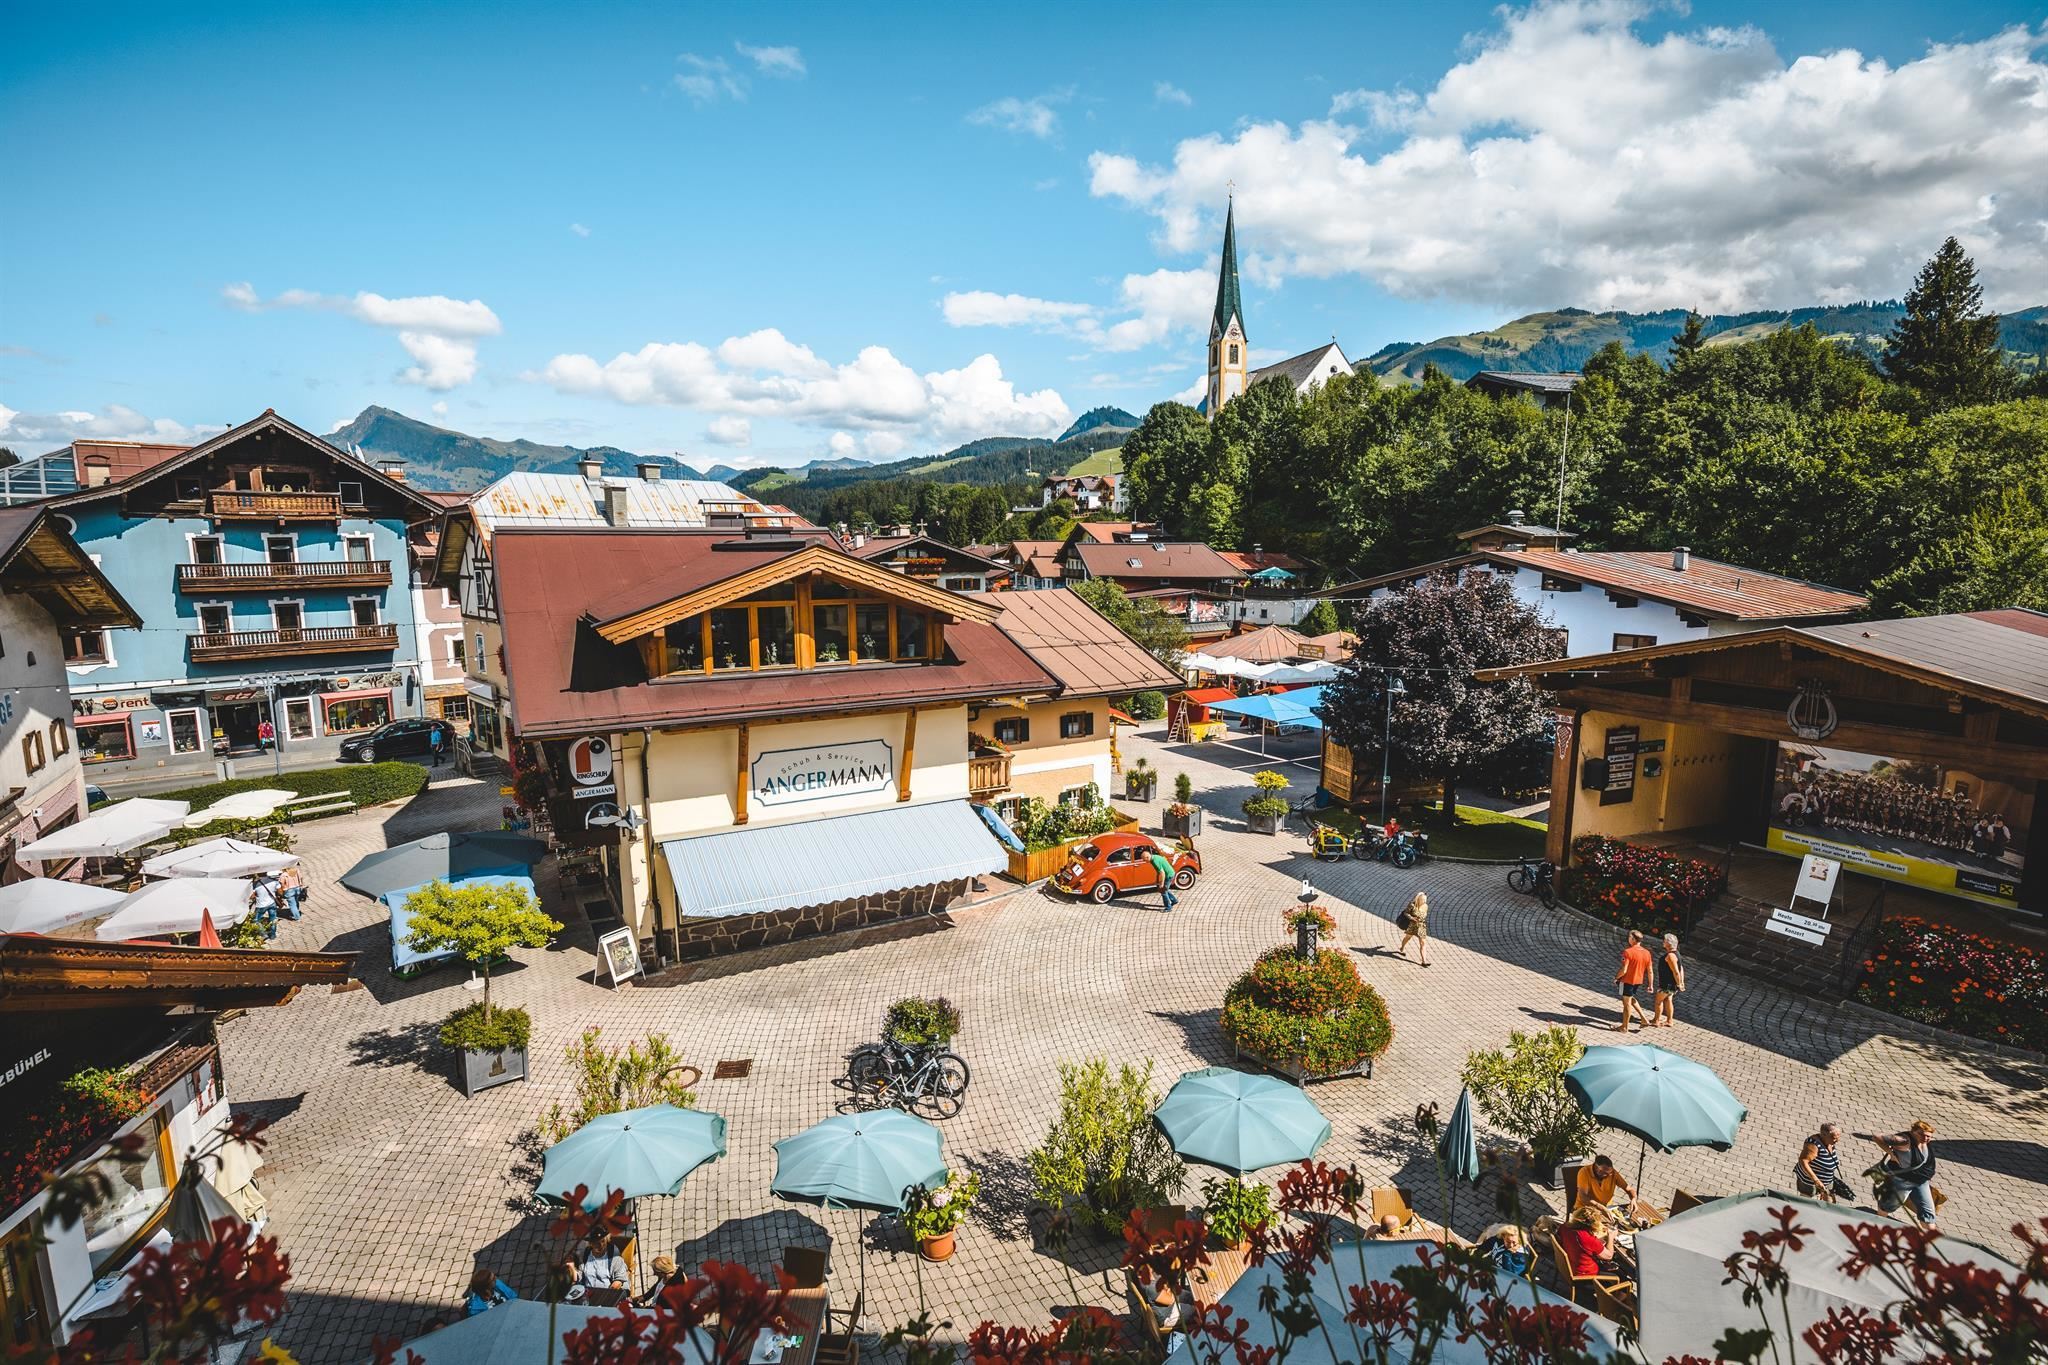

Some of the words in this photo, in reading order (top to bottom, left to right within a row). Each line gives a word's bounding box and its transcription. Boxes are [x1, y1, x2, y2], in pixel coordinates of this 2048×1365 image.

[120, 697, 149, 708] rent
[781, 757, 810, 774] Schuh
[827, 753, 864, 765] Service
[576, 771, 608, 779] RINGSCHUH
[764, 763, 886, 795] ANGERMANN
[575, 787, 614, 797] ANGERMANN
[1777, 912, 1793, 921] Heute
[1784, 927, 1805, 937] Konzert
